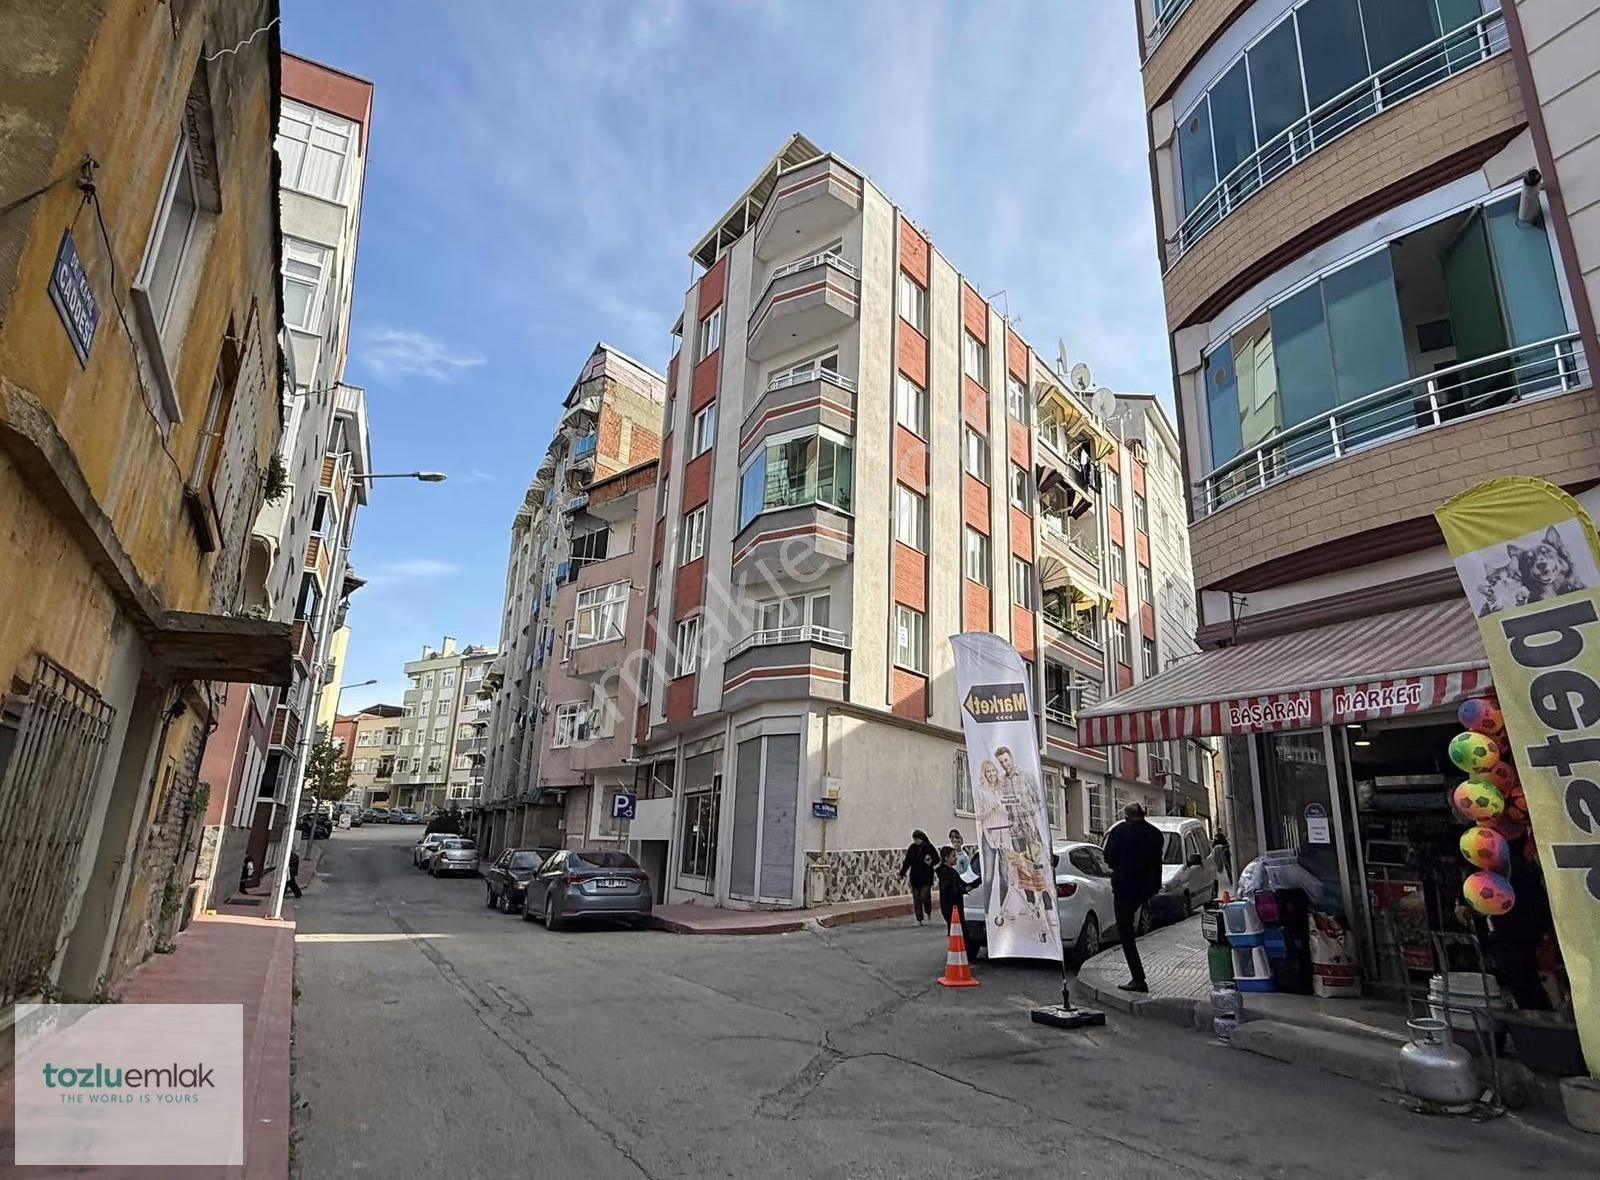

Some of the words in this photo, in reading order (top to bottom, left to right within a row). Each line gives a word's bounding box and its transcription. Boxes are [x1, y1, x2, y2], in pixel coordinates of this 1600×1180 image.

[1229, 699, 1311, 727] BAŞARAN
[1336, 684, 1422, 714] MARKET
[613, 795, 629, 817] P
